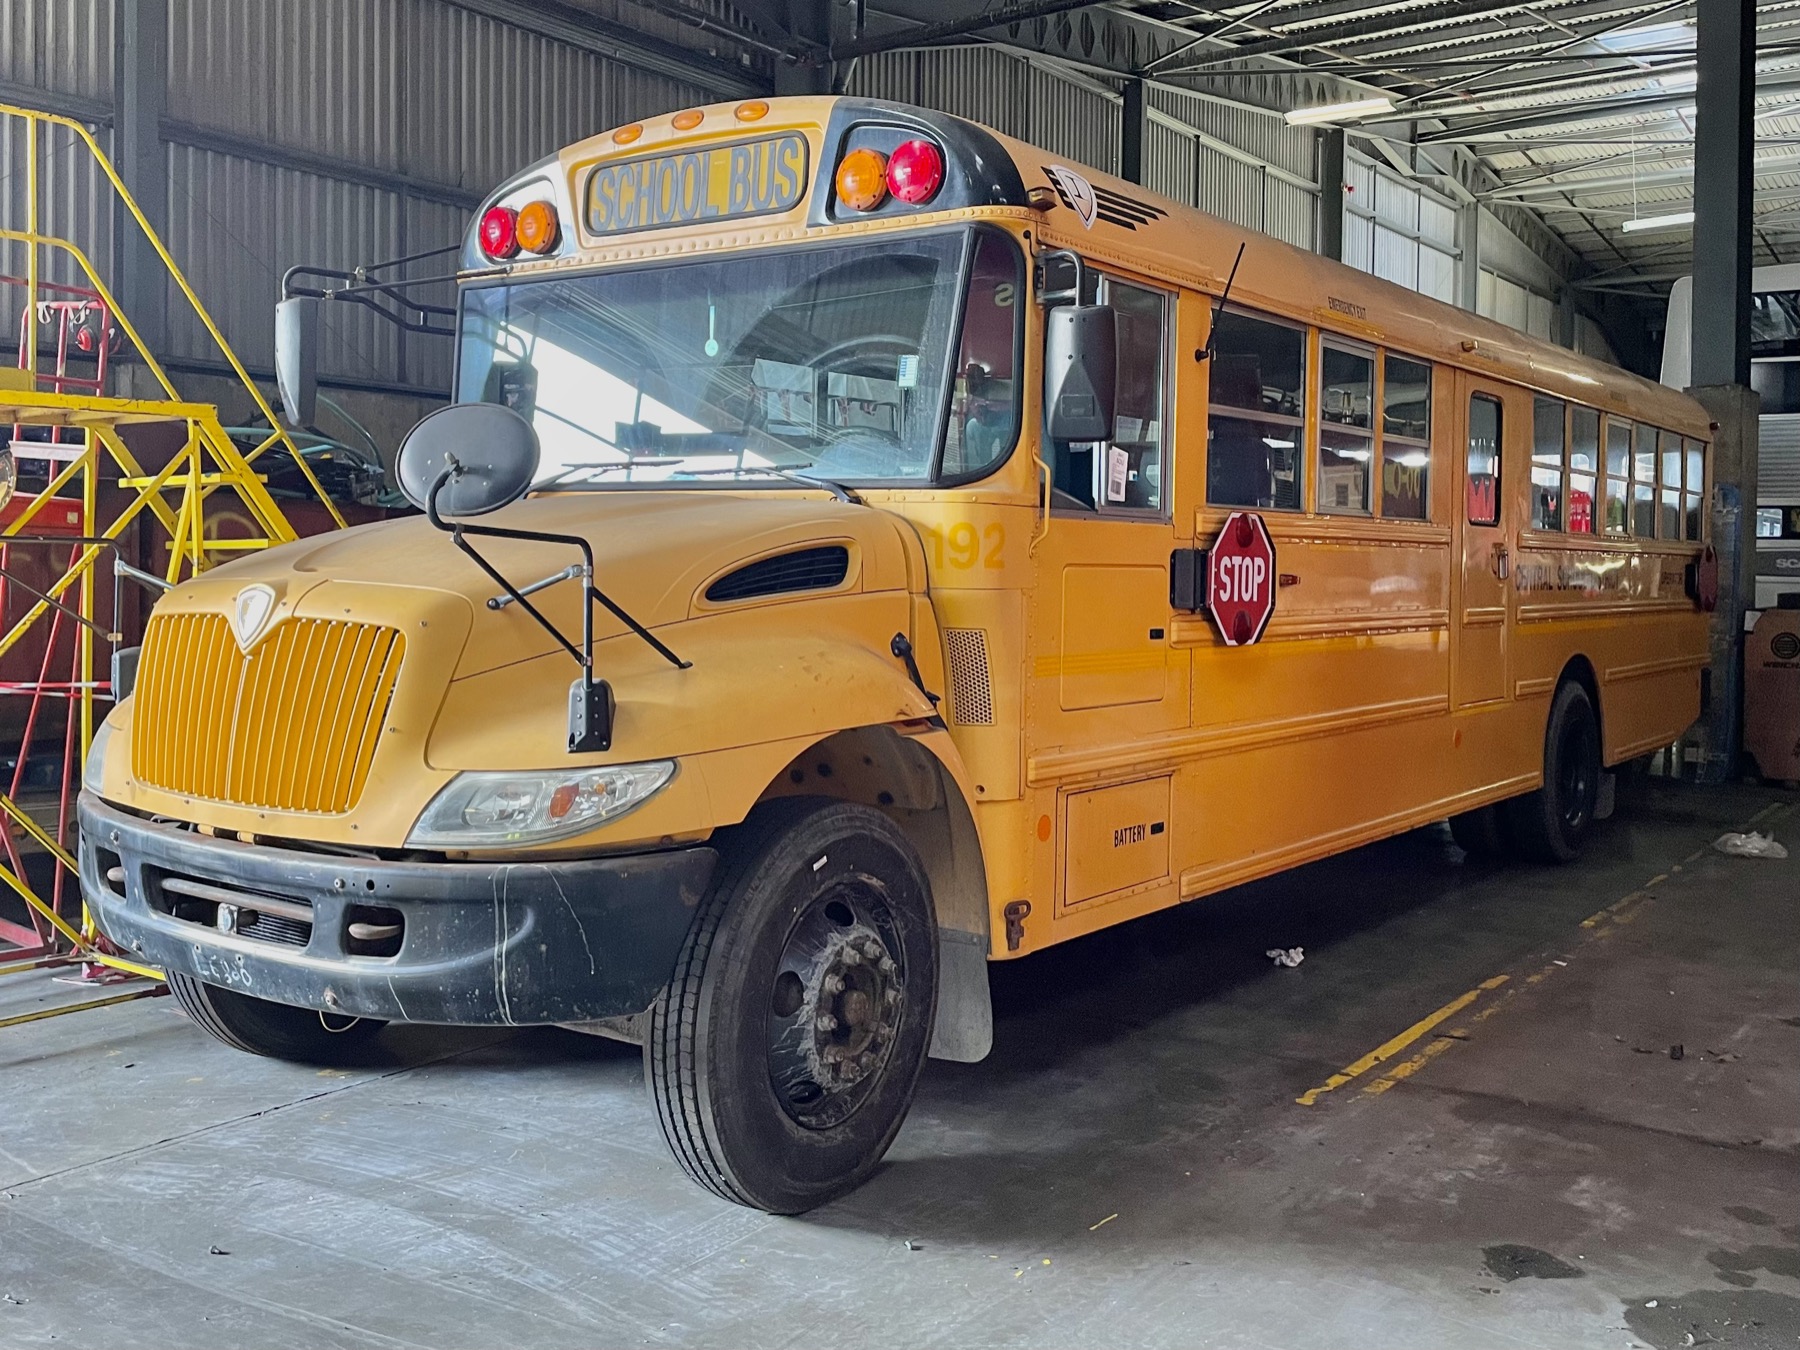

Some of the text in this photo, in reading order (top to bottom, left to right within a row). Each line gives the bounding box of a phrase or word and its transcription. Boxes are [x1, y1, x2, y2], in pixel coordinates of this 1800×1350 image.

[593, 137, 799, 232] SCHOOL BUS
[927, 521, 1006, 570] 192
[1776, 558, 1800, 569] SC
[1219, 555, 1266, 602] STOP
[1114, 823, 1147, 848] BATTERY
